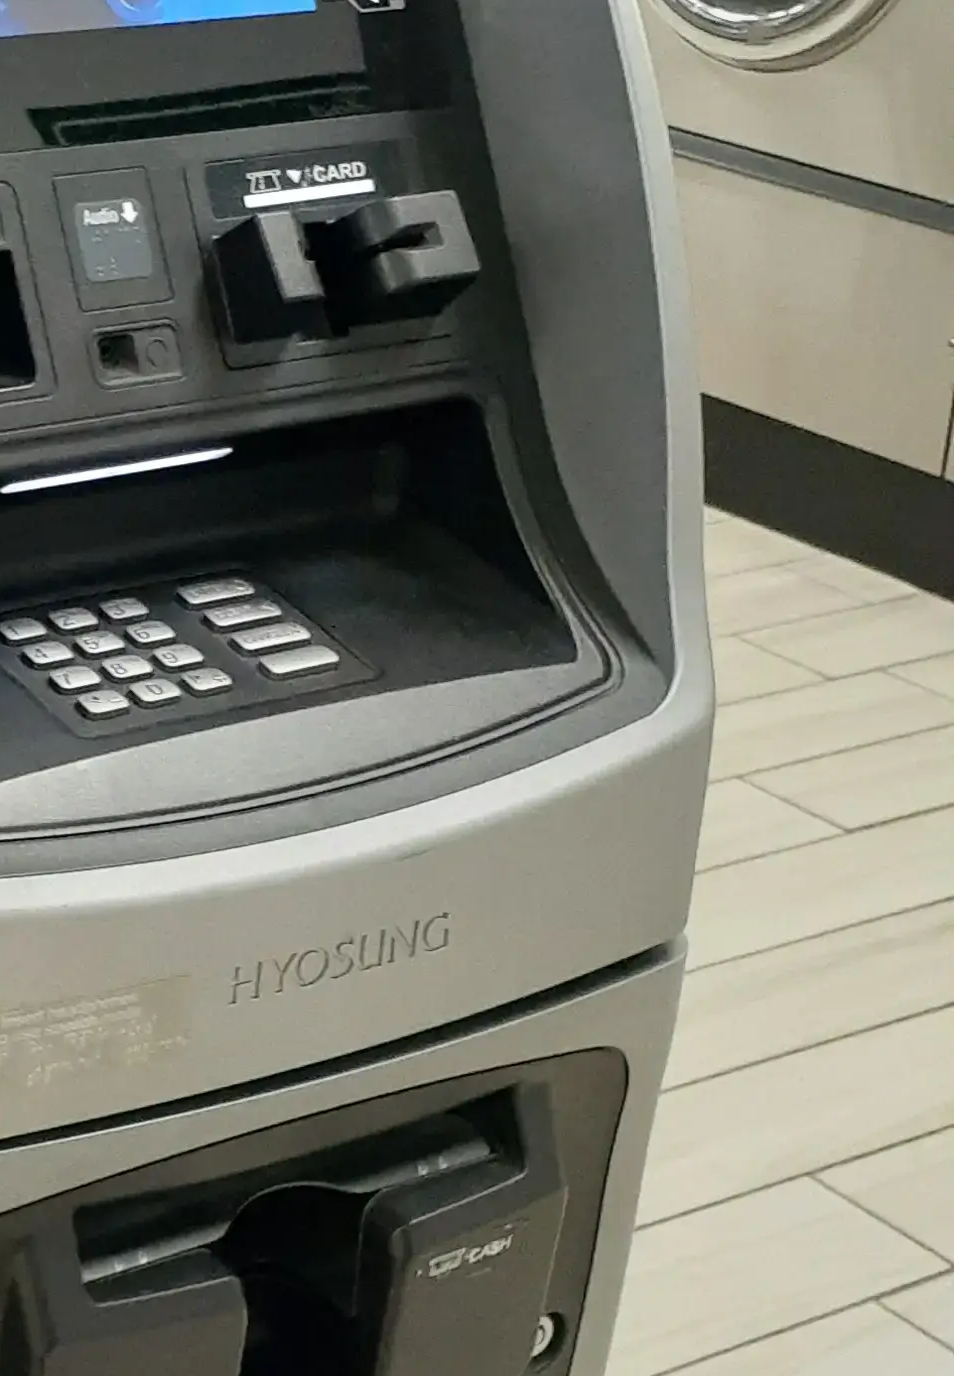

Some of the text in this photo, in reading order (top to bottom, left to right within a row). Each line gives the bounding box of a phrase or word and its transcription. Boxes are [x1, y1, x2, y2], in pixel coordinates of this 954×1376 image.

[312, 161, 367, 183] CARD
[82, 207, 120, 226] Audio
[228, 912, 450, 1005] HYOSUNG
[468, 1233, 515, 1264] CASH
